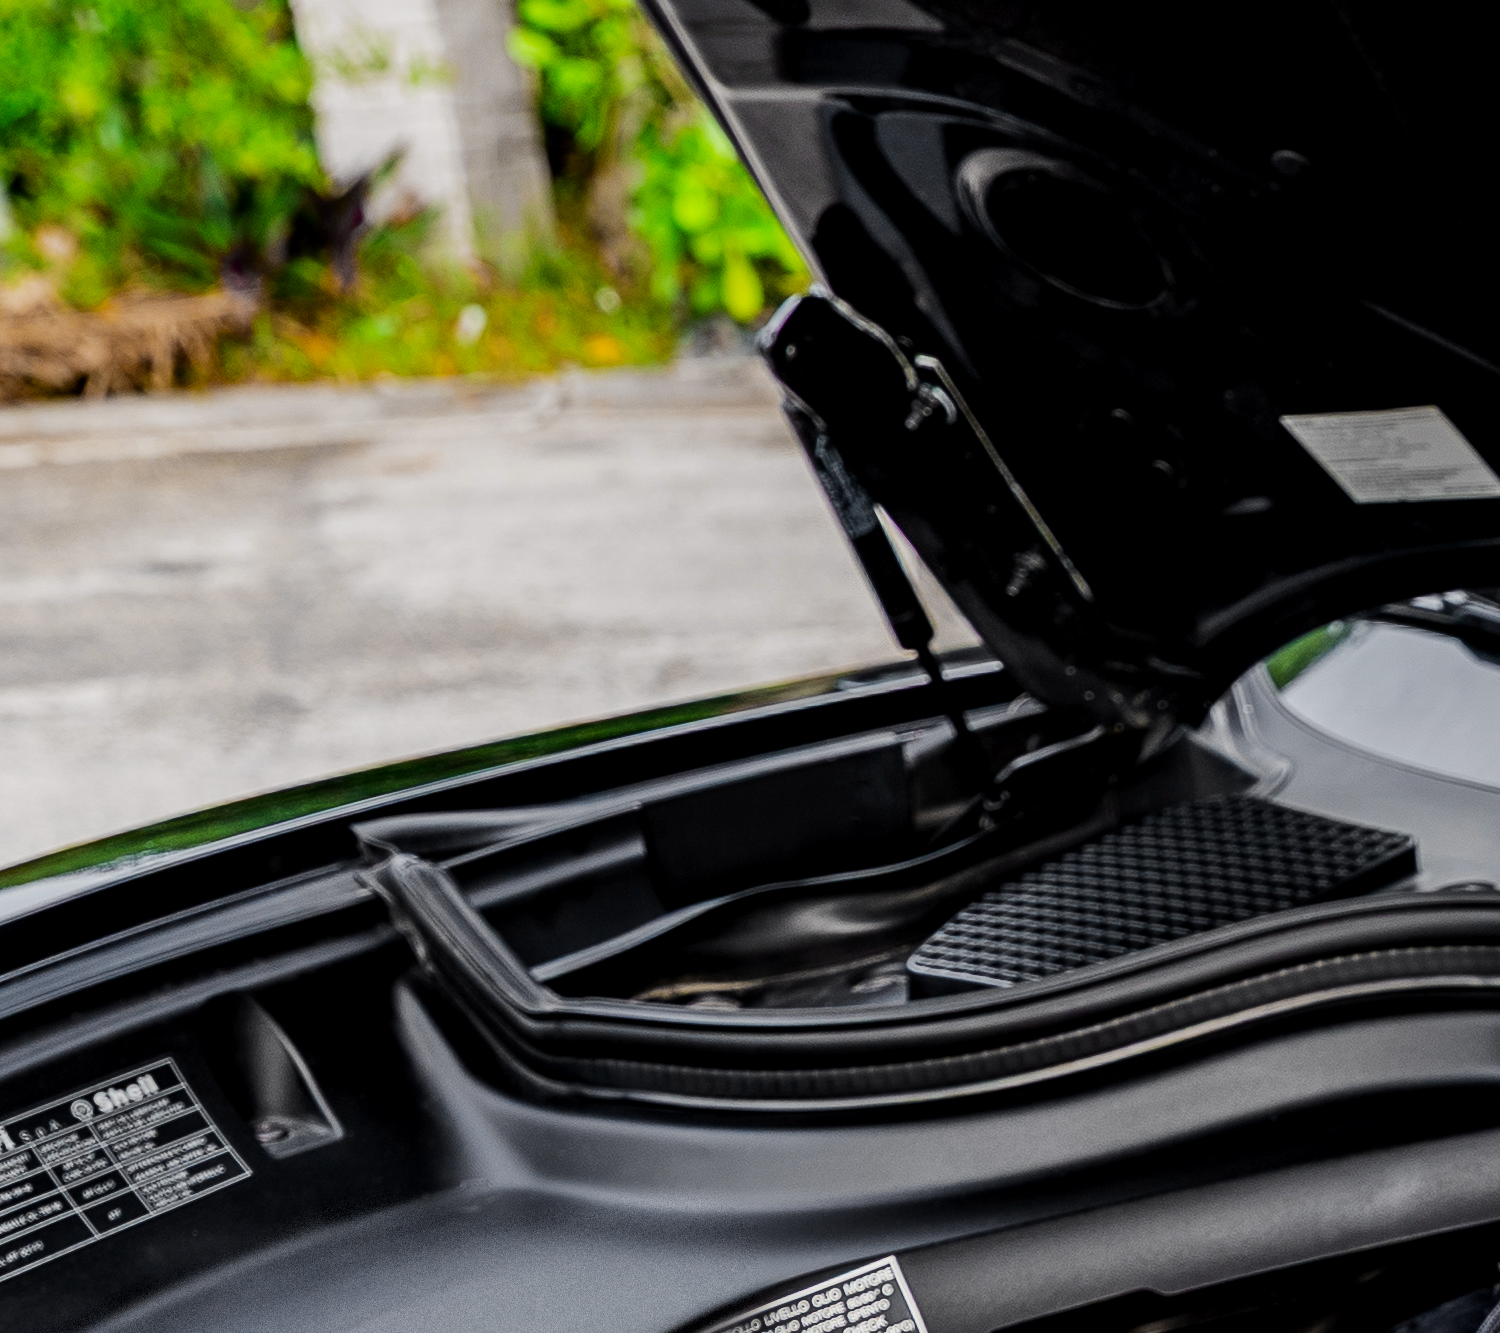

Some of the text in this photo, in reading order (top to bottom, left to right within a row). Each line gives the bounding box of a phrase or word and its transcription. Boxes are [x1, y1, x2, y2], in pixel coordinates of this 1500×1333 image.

[93, 1074, 160, 1113] Shell
[762, 1298, 811, 1328] LIVELLO
[810, 1286, 842, 1309] OLIO
[842, 1266, 894, 1297] MOTORE
[846, 1297, 891, 1324] SPENTO
[800, 1301, 846, 1328] MOTORE
